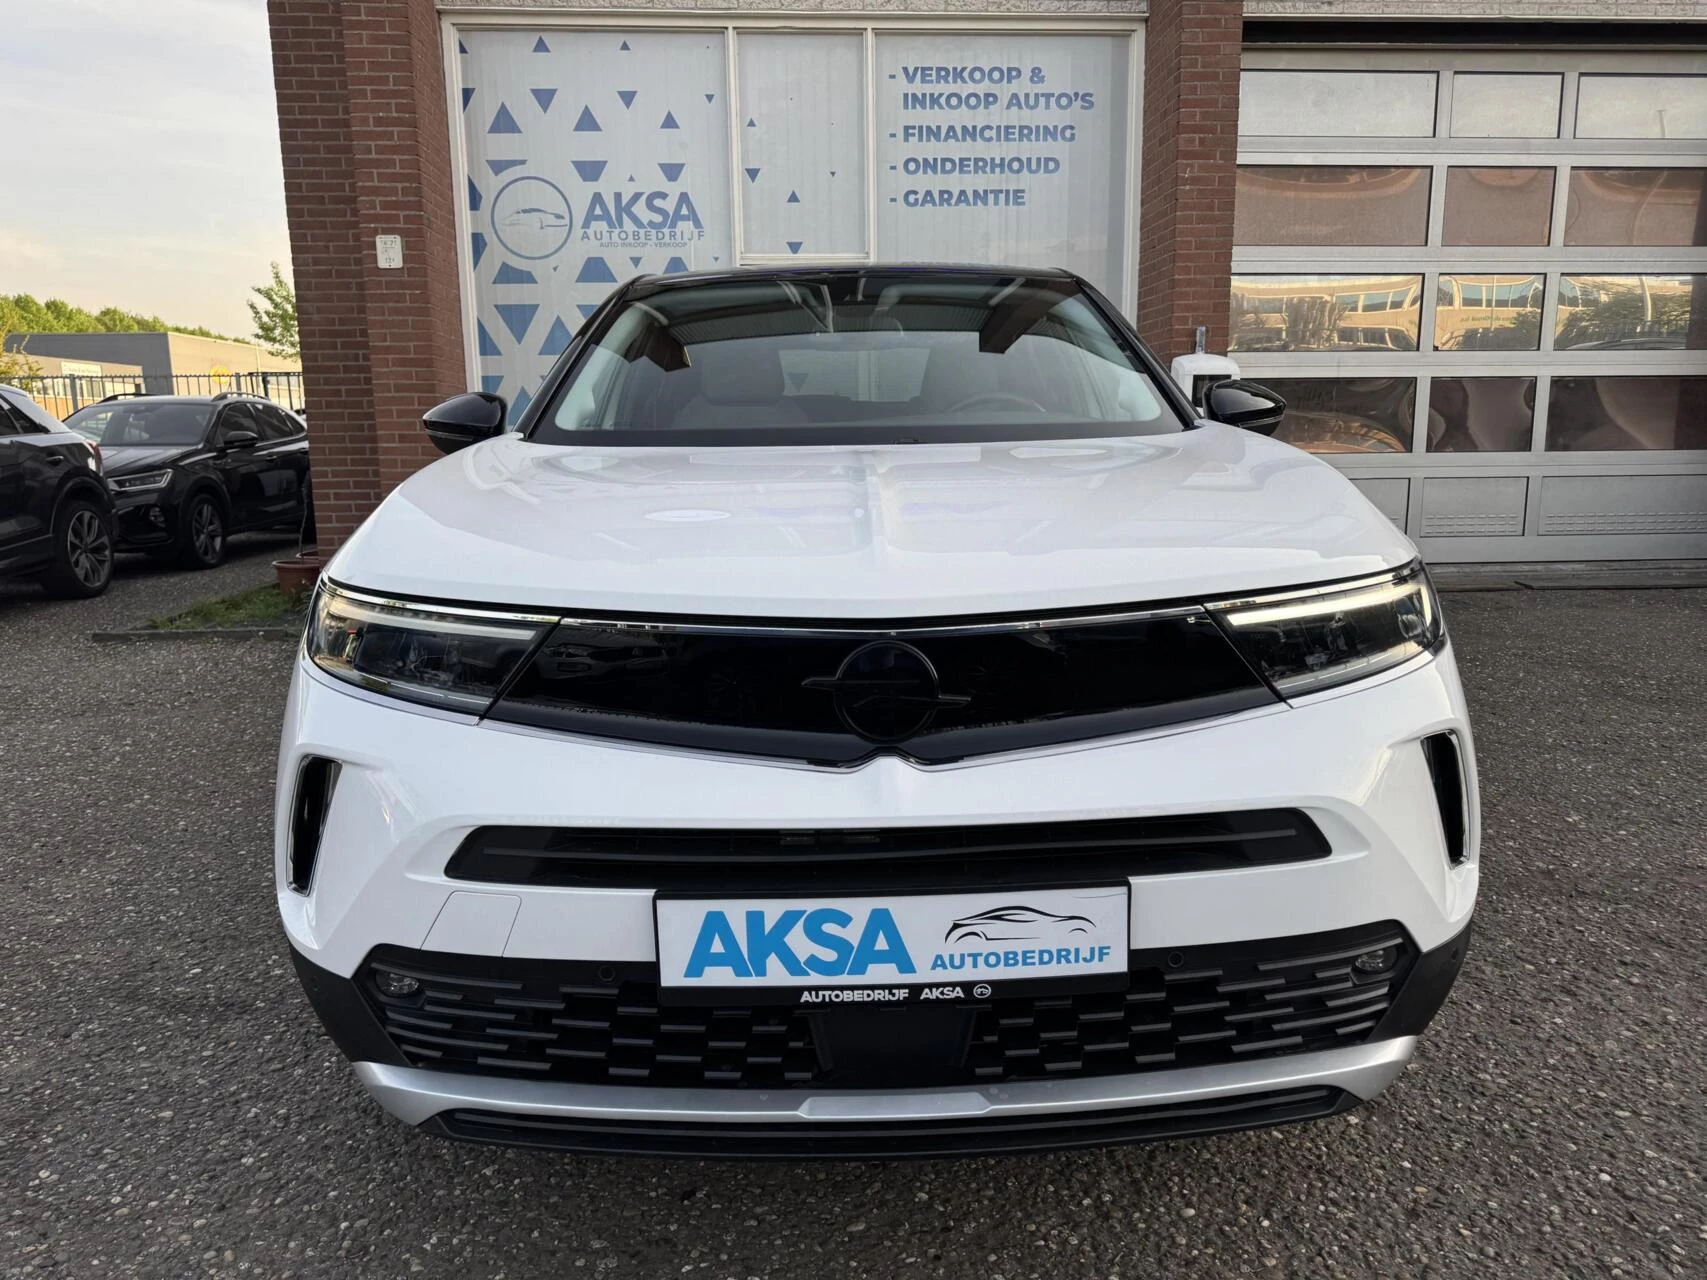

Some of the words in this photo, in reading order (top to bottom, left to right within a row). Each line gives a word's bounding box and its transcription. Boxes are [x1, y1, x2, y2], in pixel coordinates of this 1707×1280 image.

[901, 66, 1022, 85] VERKOOP
[1029, 66, 1046, 85] &
[902, 92, 999, 111] INKOOP
[1005, 92, 1095, 111] AUTO'S
[902, 124, 1077, 143] FINANCIERING
[902, 156, 1061, 175] ONDERHOUD
[902, 189, 1026, 207] GARANTIE
[580, 191, 704, 230] AKSA
[580, 230, 705, 241] AUTOBEDRIJF
[683, 907, 917, 978] AKSA
[930, 945, 1112, 971] AUTOBEDRIJF
[800, 989, 909, 1003] AUTOBEDRIJF
[919, 986, 965, 1000] AKSA
